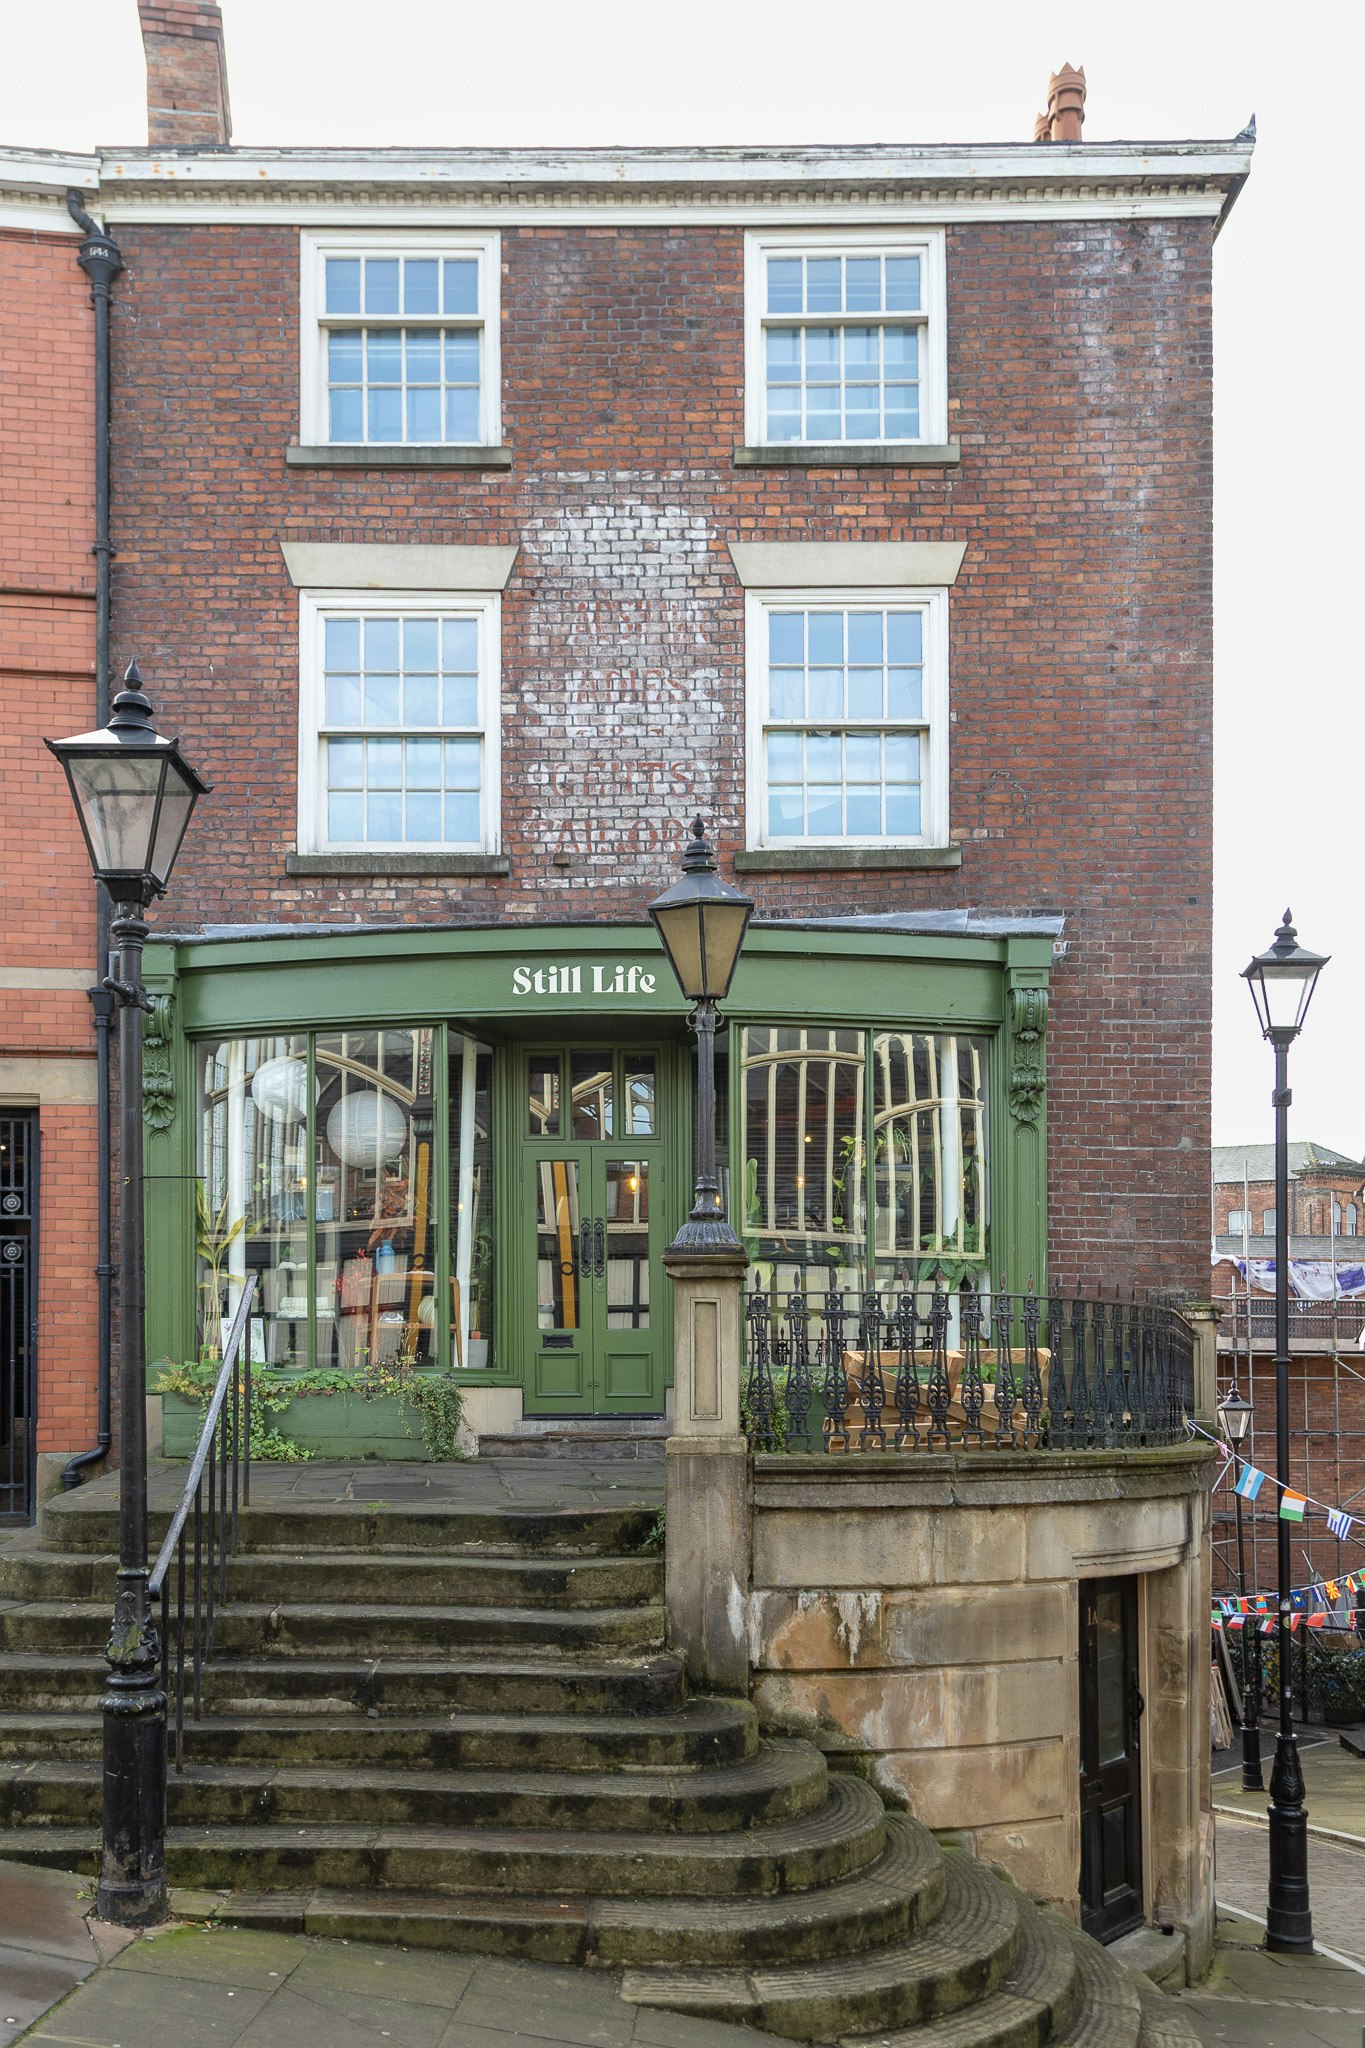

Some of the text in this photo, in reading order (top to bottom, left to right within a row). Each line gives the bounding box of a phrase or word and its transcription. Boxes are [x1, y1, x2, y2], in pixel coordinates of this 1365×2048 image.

[564, 667, 693, 704] ADIES
[536, 817, 712, 853] AILOR
[512, 965, 656, 995] Still Life
